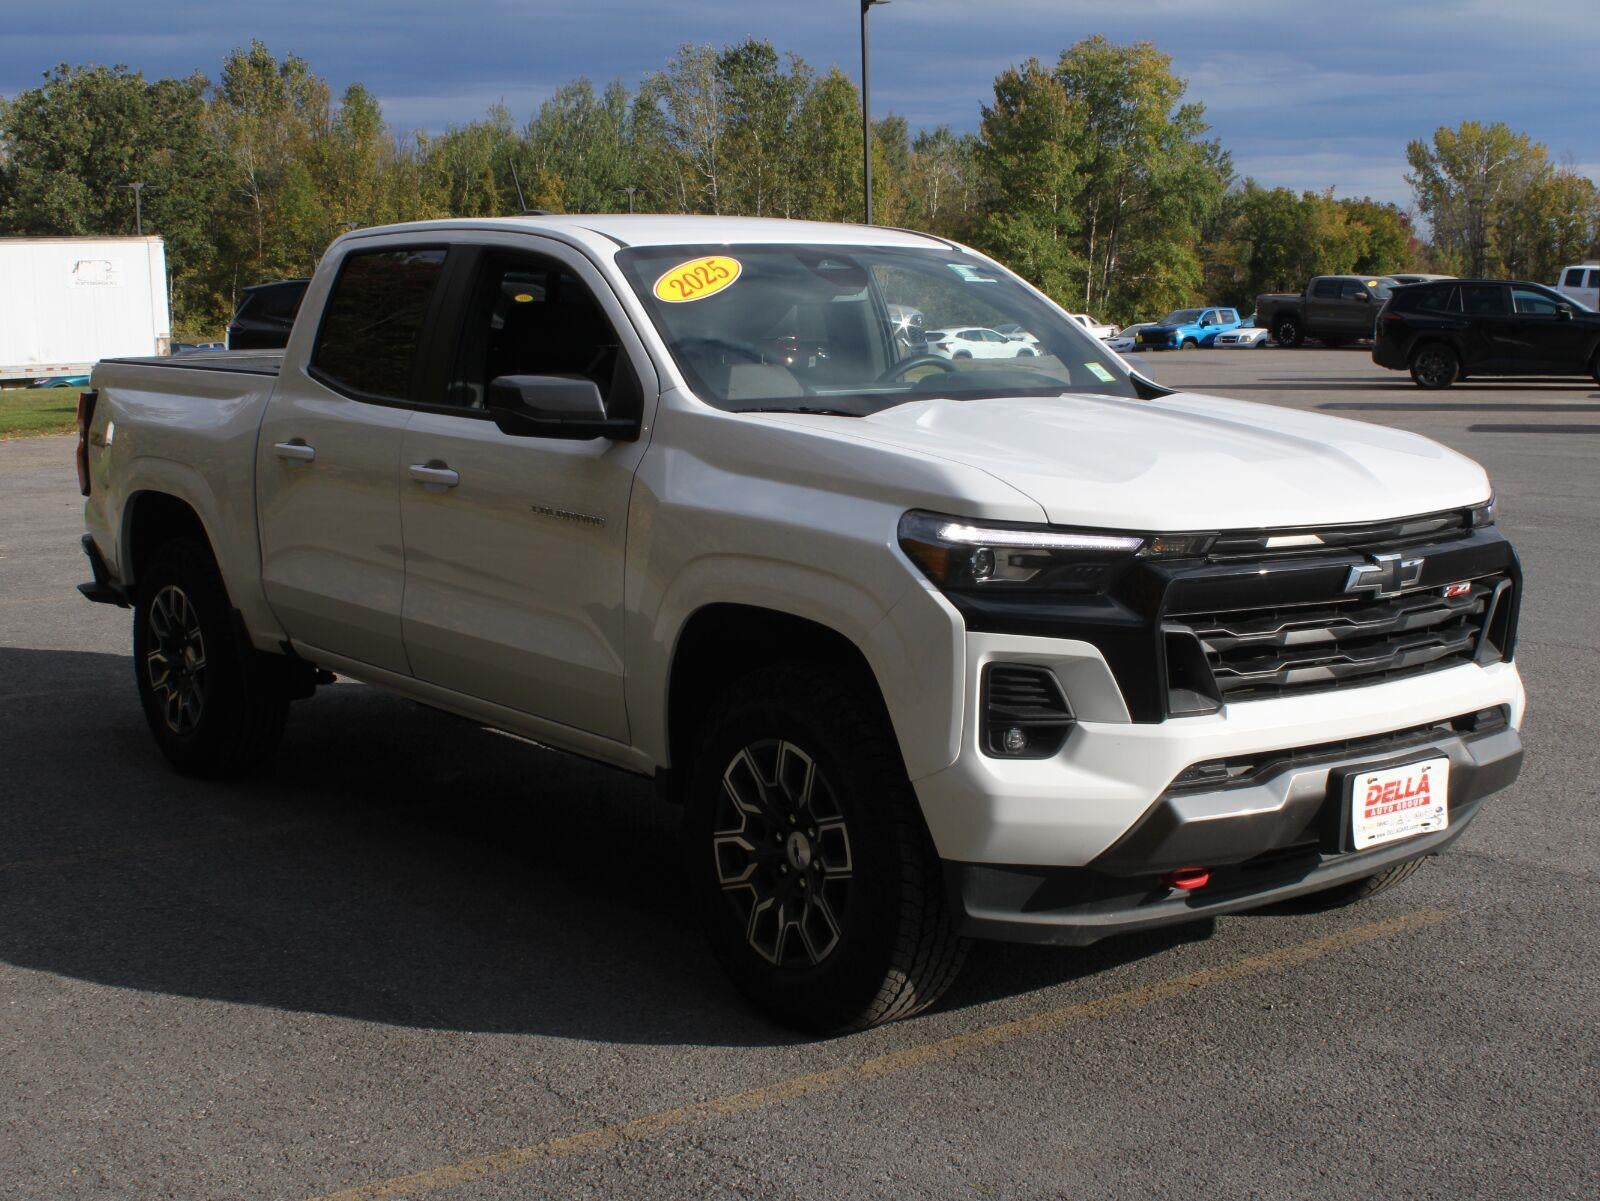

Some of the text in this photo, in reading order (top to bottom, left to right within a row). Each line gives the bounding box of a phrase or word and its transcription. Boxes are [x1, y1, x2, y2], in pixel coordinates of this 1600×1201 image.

[669, 260, 729, 297] 2025
[1366, 774, 1430, 806] DELLA
[1370, 798, 1424, 817] AUTO GROUP
